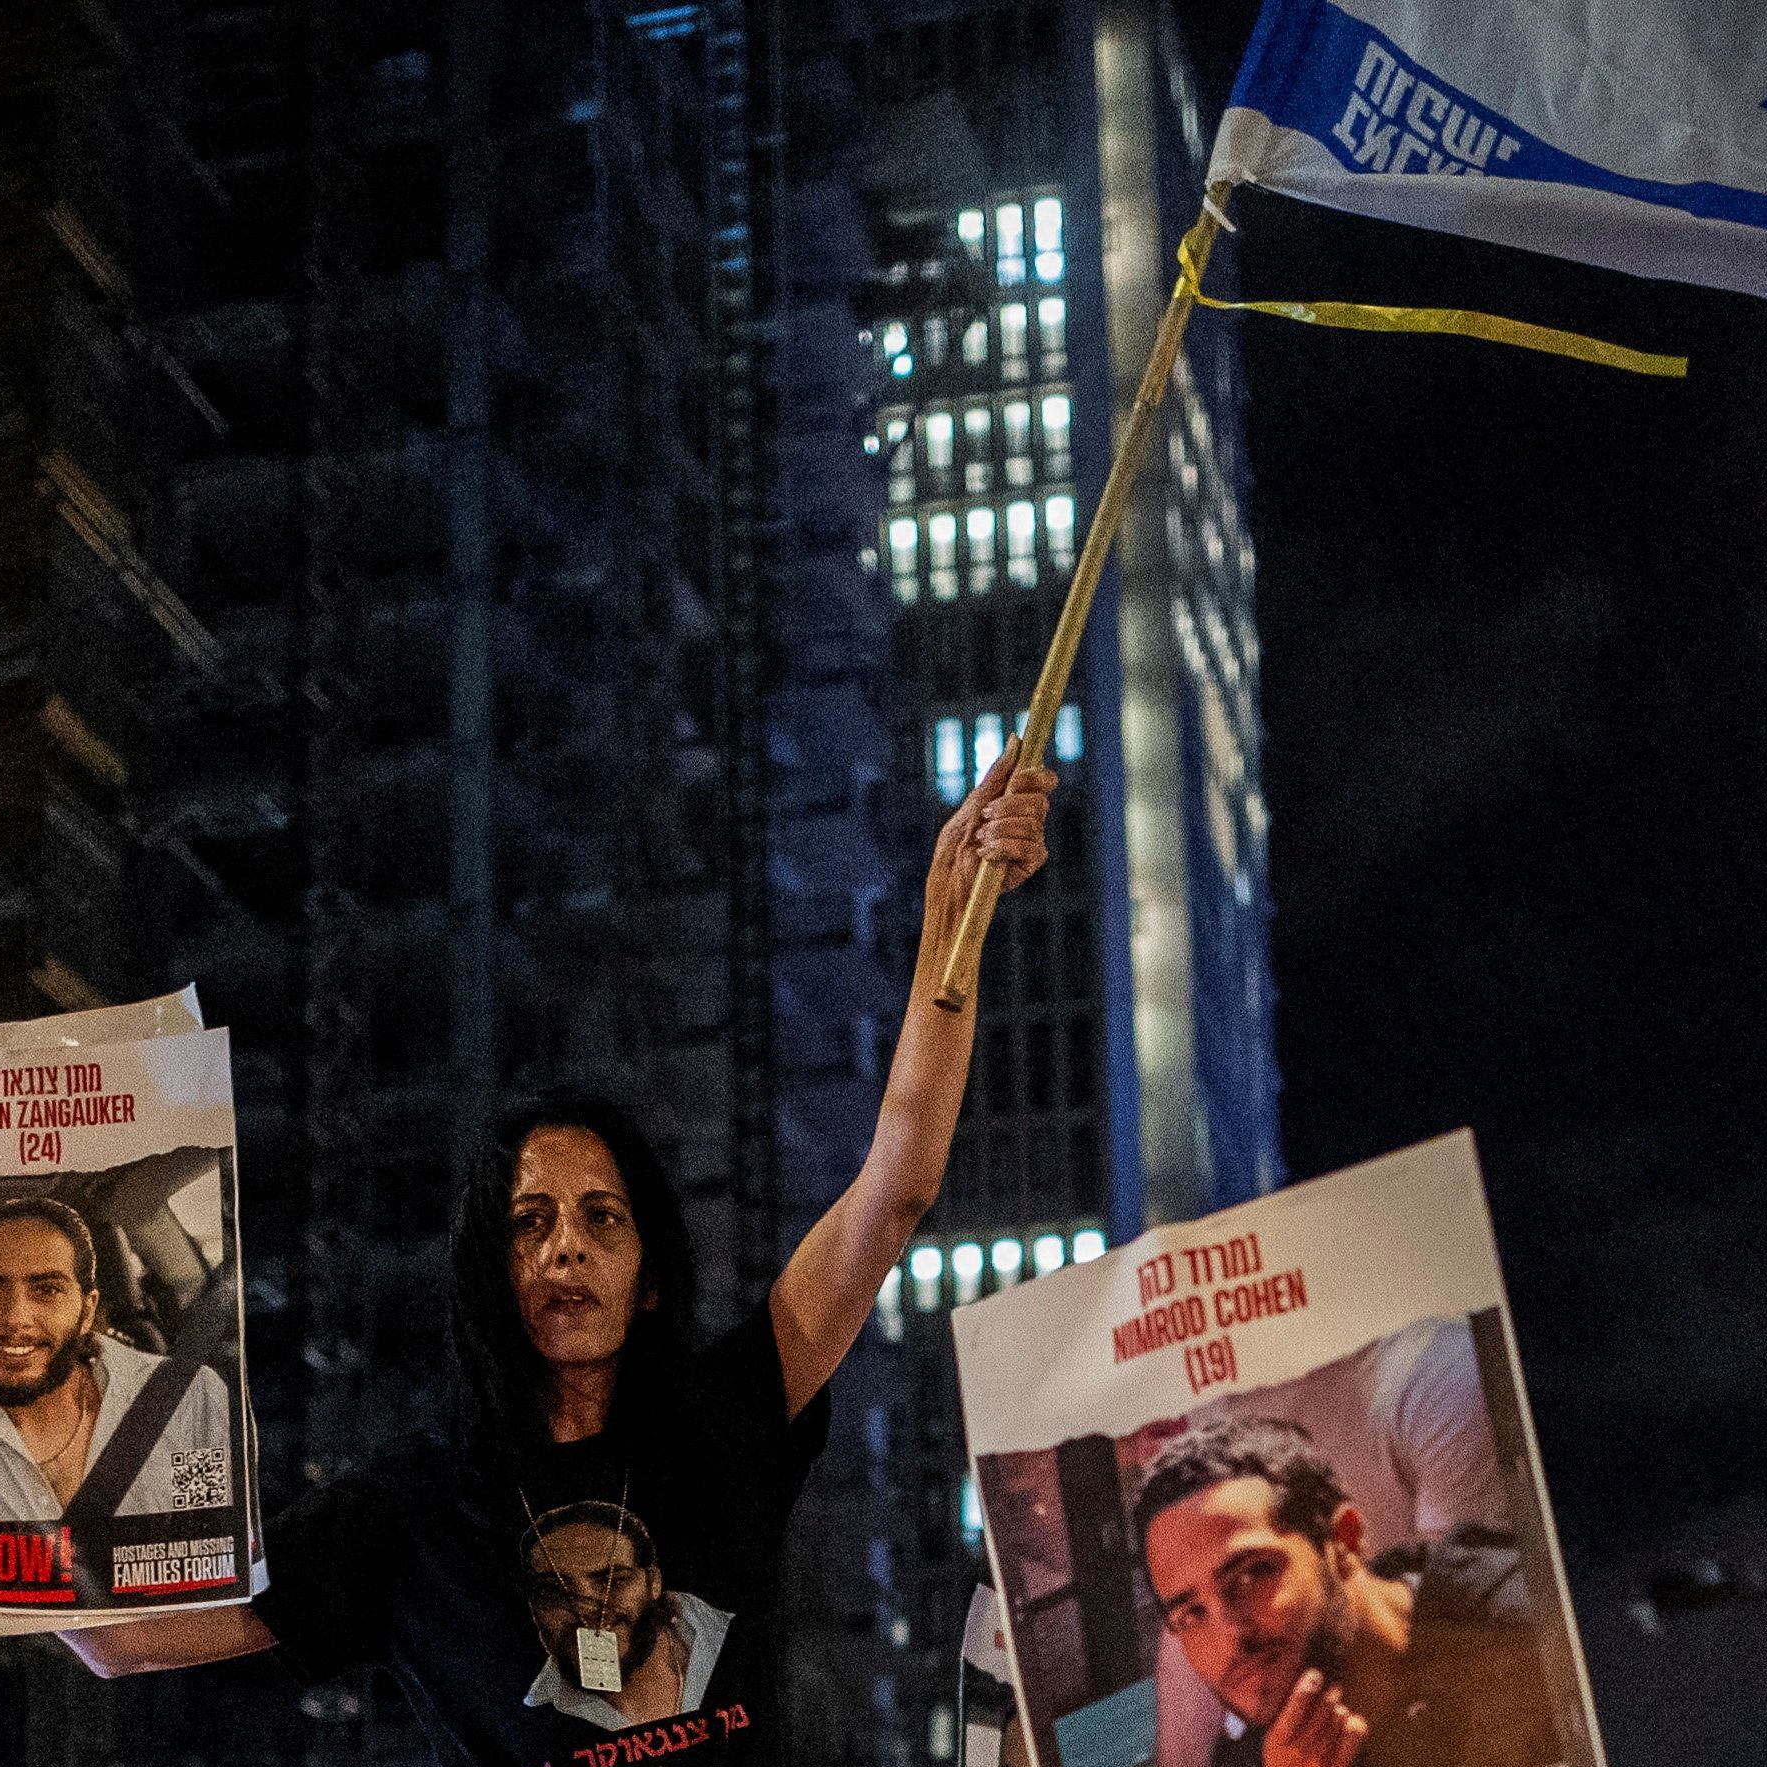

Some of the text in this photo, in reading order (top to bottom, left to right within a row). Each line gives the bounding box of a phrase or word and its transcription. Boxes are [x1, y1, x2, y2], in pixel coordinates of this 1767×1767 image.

[64, 1063, 101, 1097] מתן
[17, 1094, 136, 1129] ZANGAUKER
[19, 1132, 62, 1165] (24)
[1137, 1232, 1262, 1306] נמרוד כהן
[1113, 1266, 1308, 1363] NIMROD COHEN
[1184, 1336, 1239, 1394] (19)
[112, 1535, 235, 1563] HOSTAGES AND MISSING
[114, 1554, 236, 1588] FAMILIES FORUM
